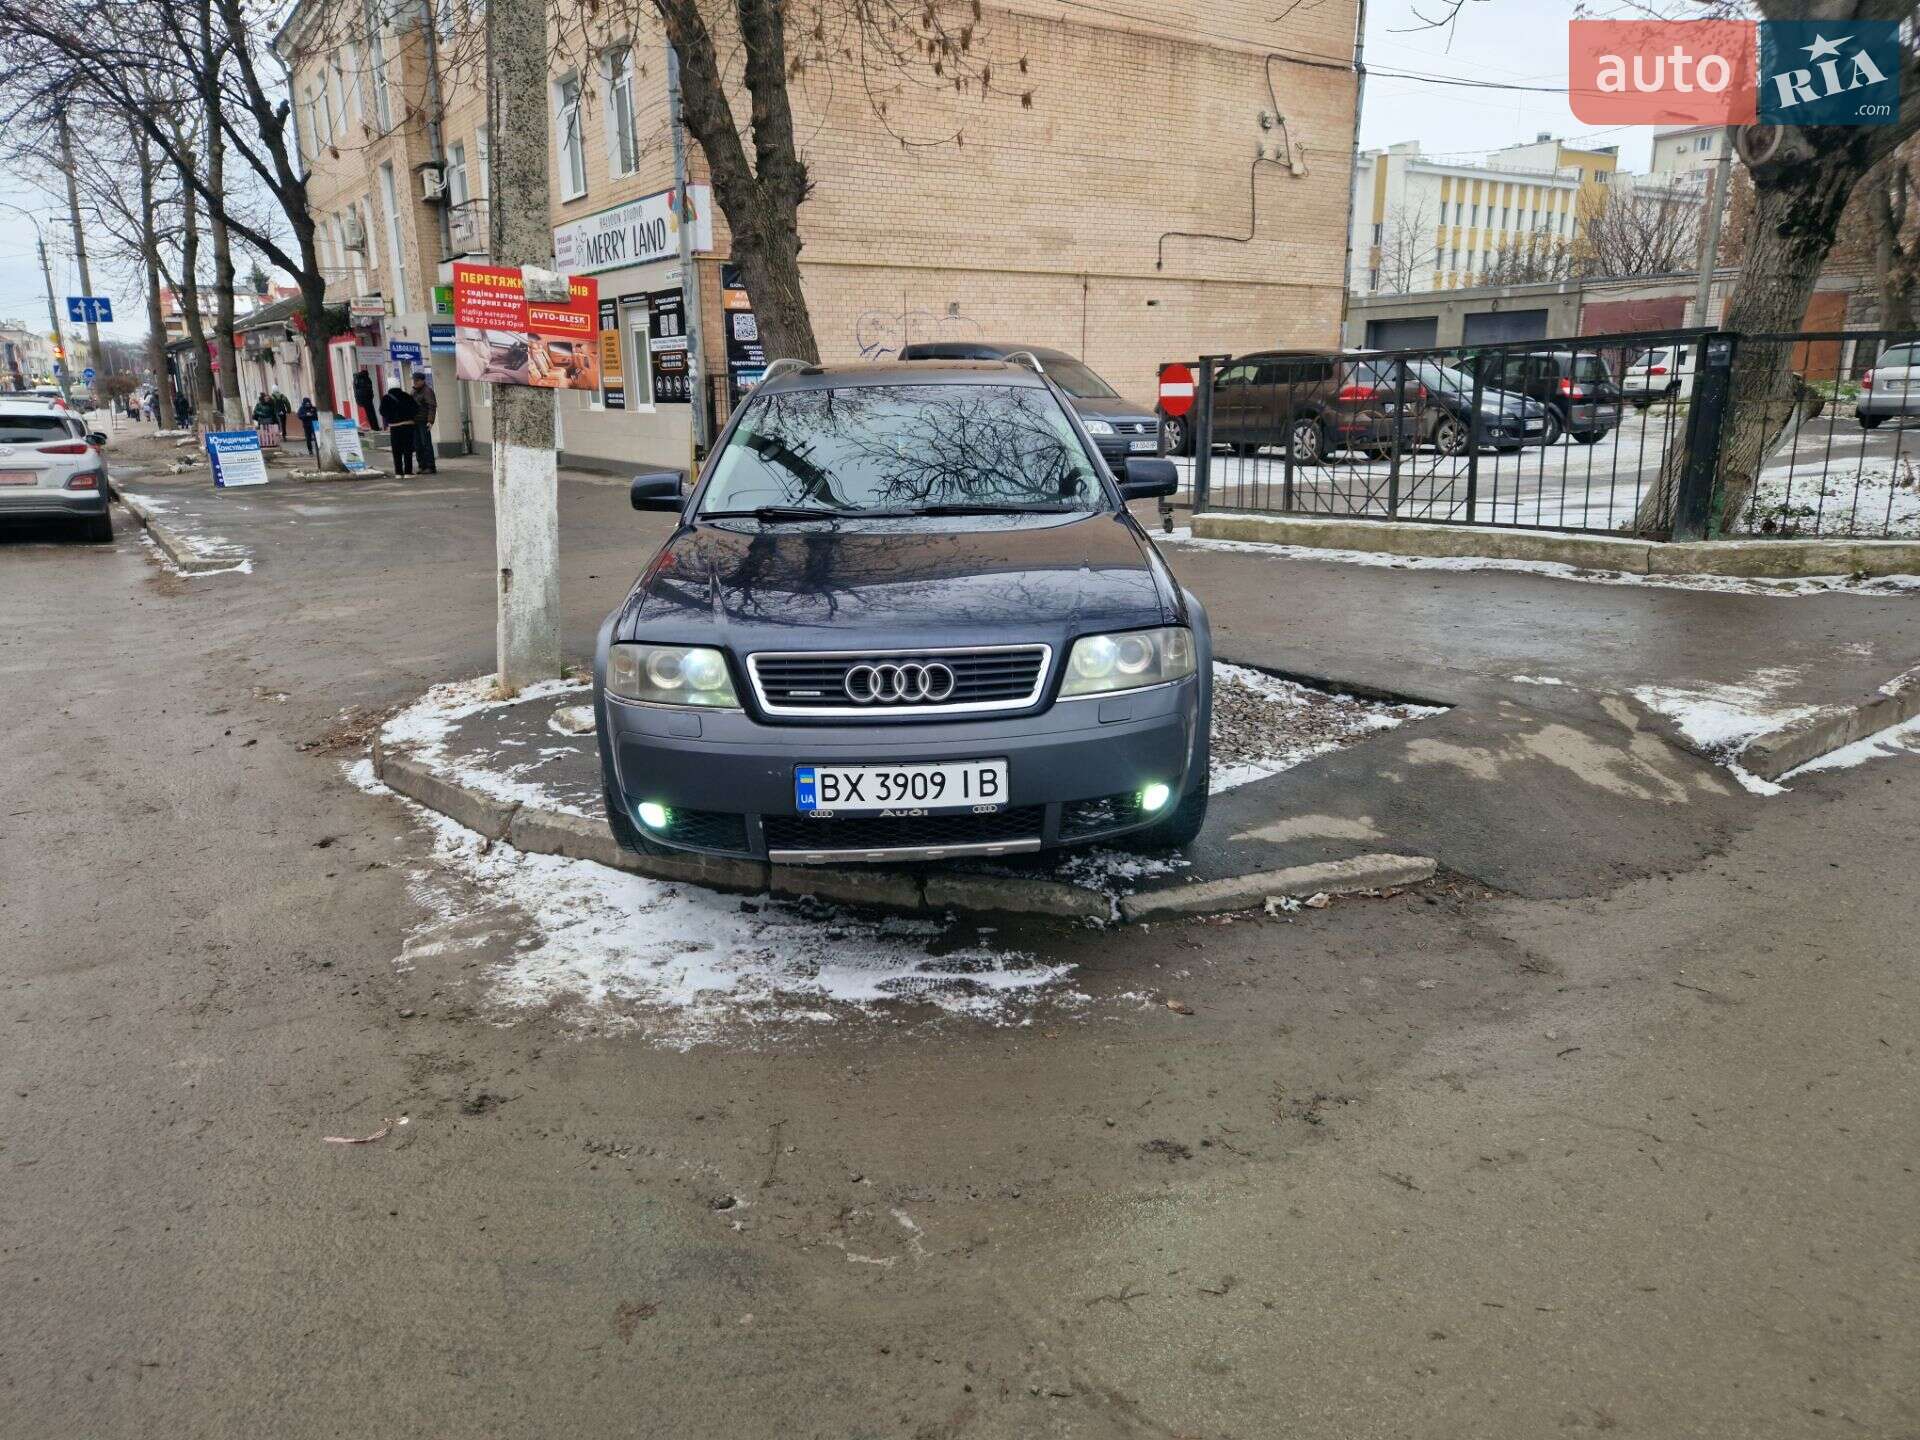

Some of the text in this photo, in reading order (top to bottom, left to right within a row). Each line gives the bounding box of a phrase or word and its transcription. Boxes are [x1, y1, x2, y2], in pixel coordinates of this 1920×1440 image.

[586, 217, 666, 265] MERRY LAND
[460, 271, 525, 289] ПЕРЕТЯЖК
[820, 768, 999, 802] BX 3909 IB
[801, 794, 815, 804] UA
